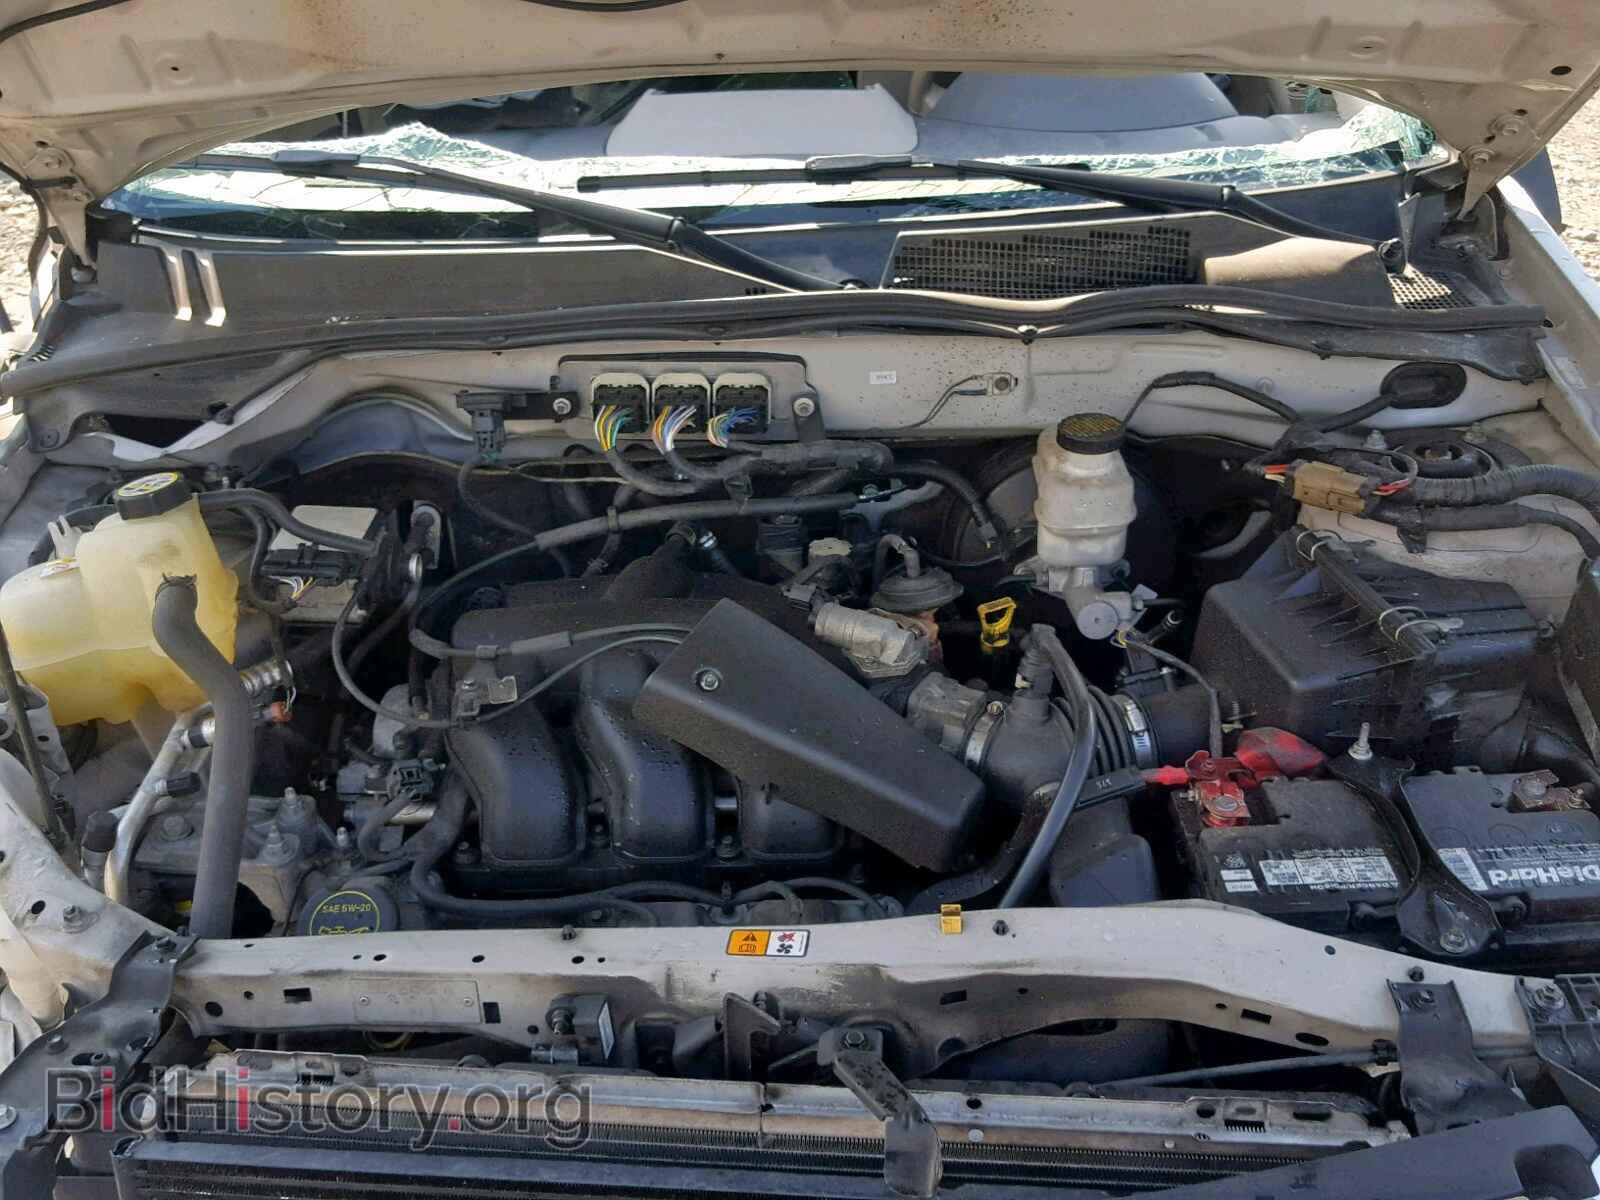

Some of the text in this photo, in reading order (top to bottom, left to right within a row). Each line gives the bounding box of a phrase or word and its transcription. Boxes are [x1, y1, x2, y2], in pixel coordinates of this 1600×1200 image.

[1488, 864, 1600, 886] DieHard
[322, 903, 372, 913] SAE 5W-20
